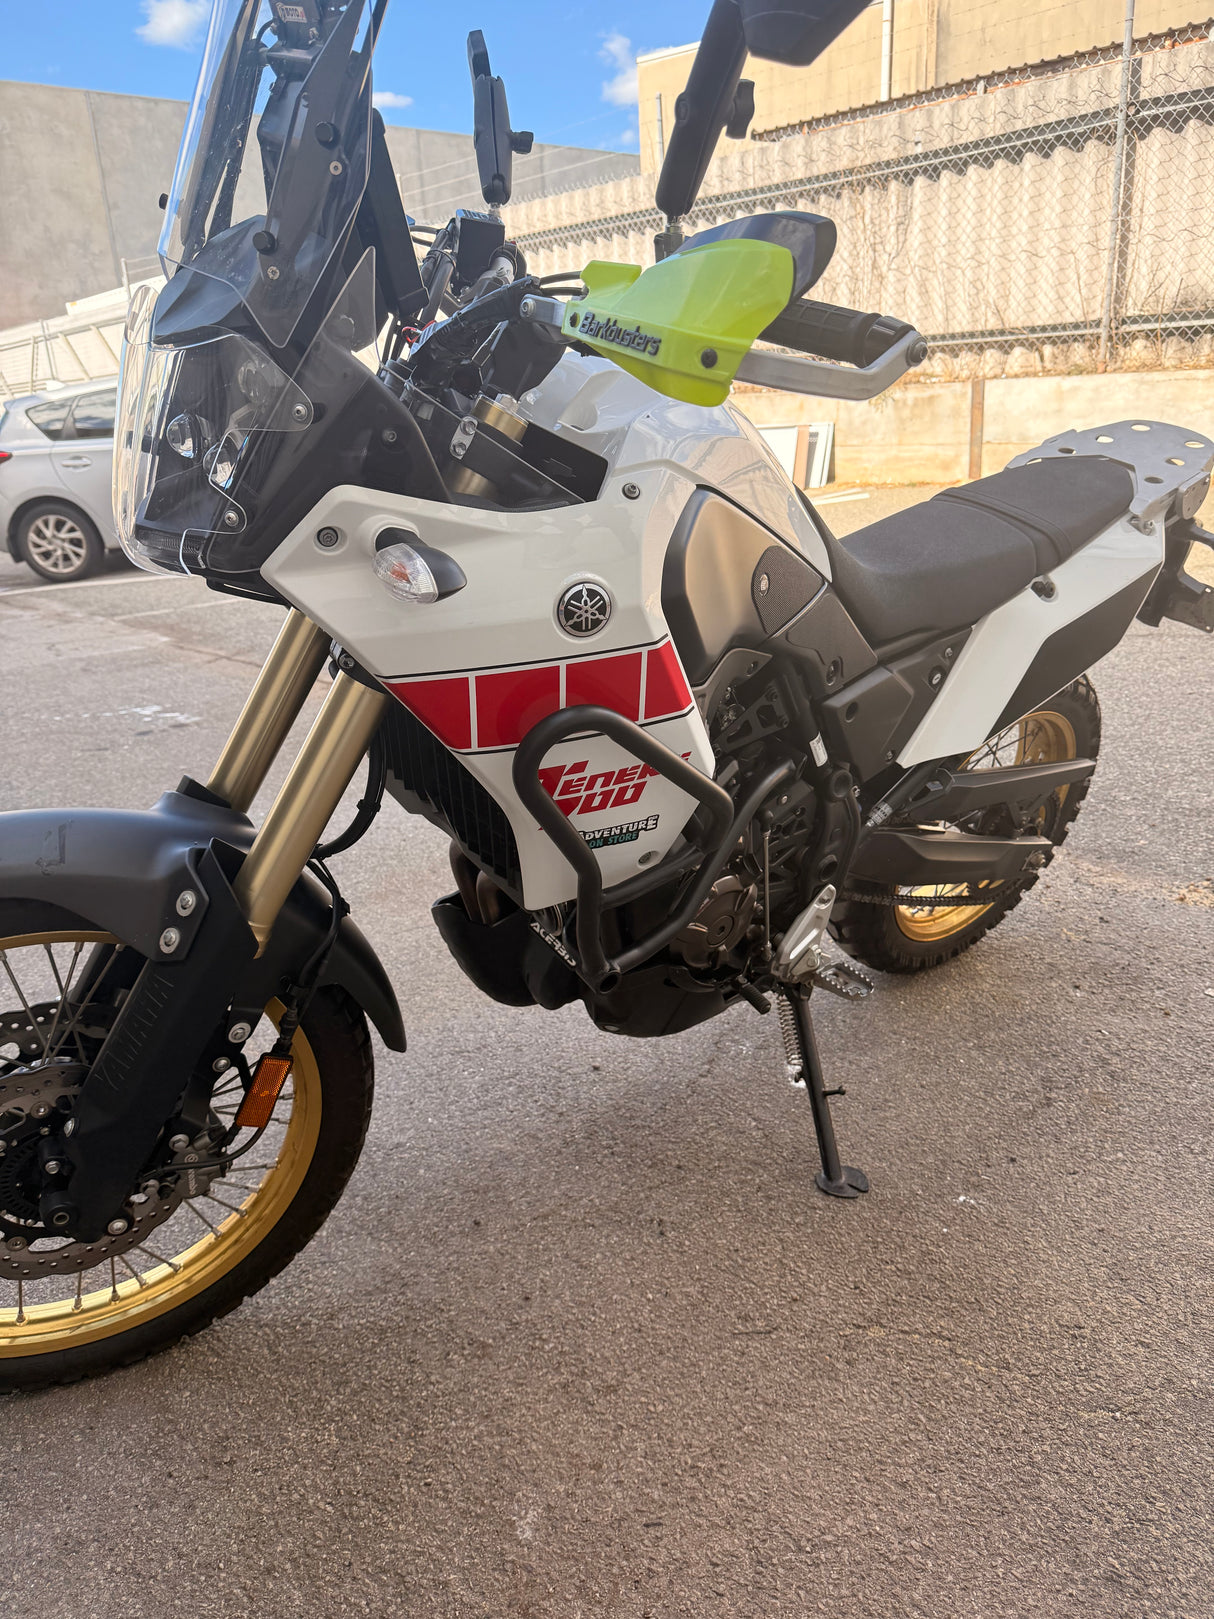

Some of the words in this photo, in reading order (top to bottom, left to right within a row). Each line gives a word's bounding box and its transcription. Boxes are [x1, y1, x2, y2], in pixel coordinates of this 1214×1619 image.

[579, 311, 662, 356] Barkbusters
[607, 832, 638, 845] STORE
[530, 922, 577, 966] ACERBIS
[94, 973, 175, 1091] YAMAHA
